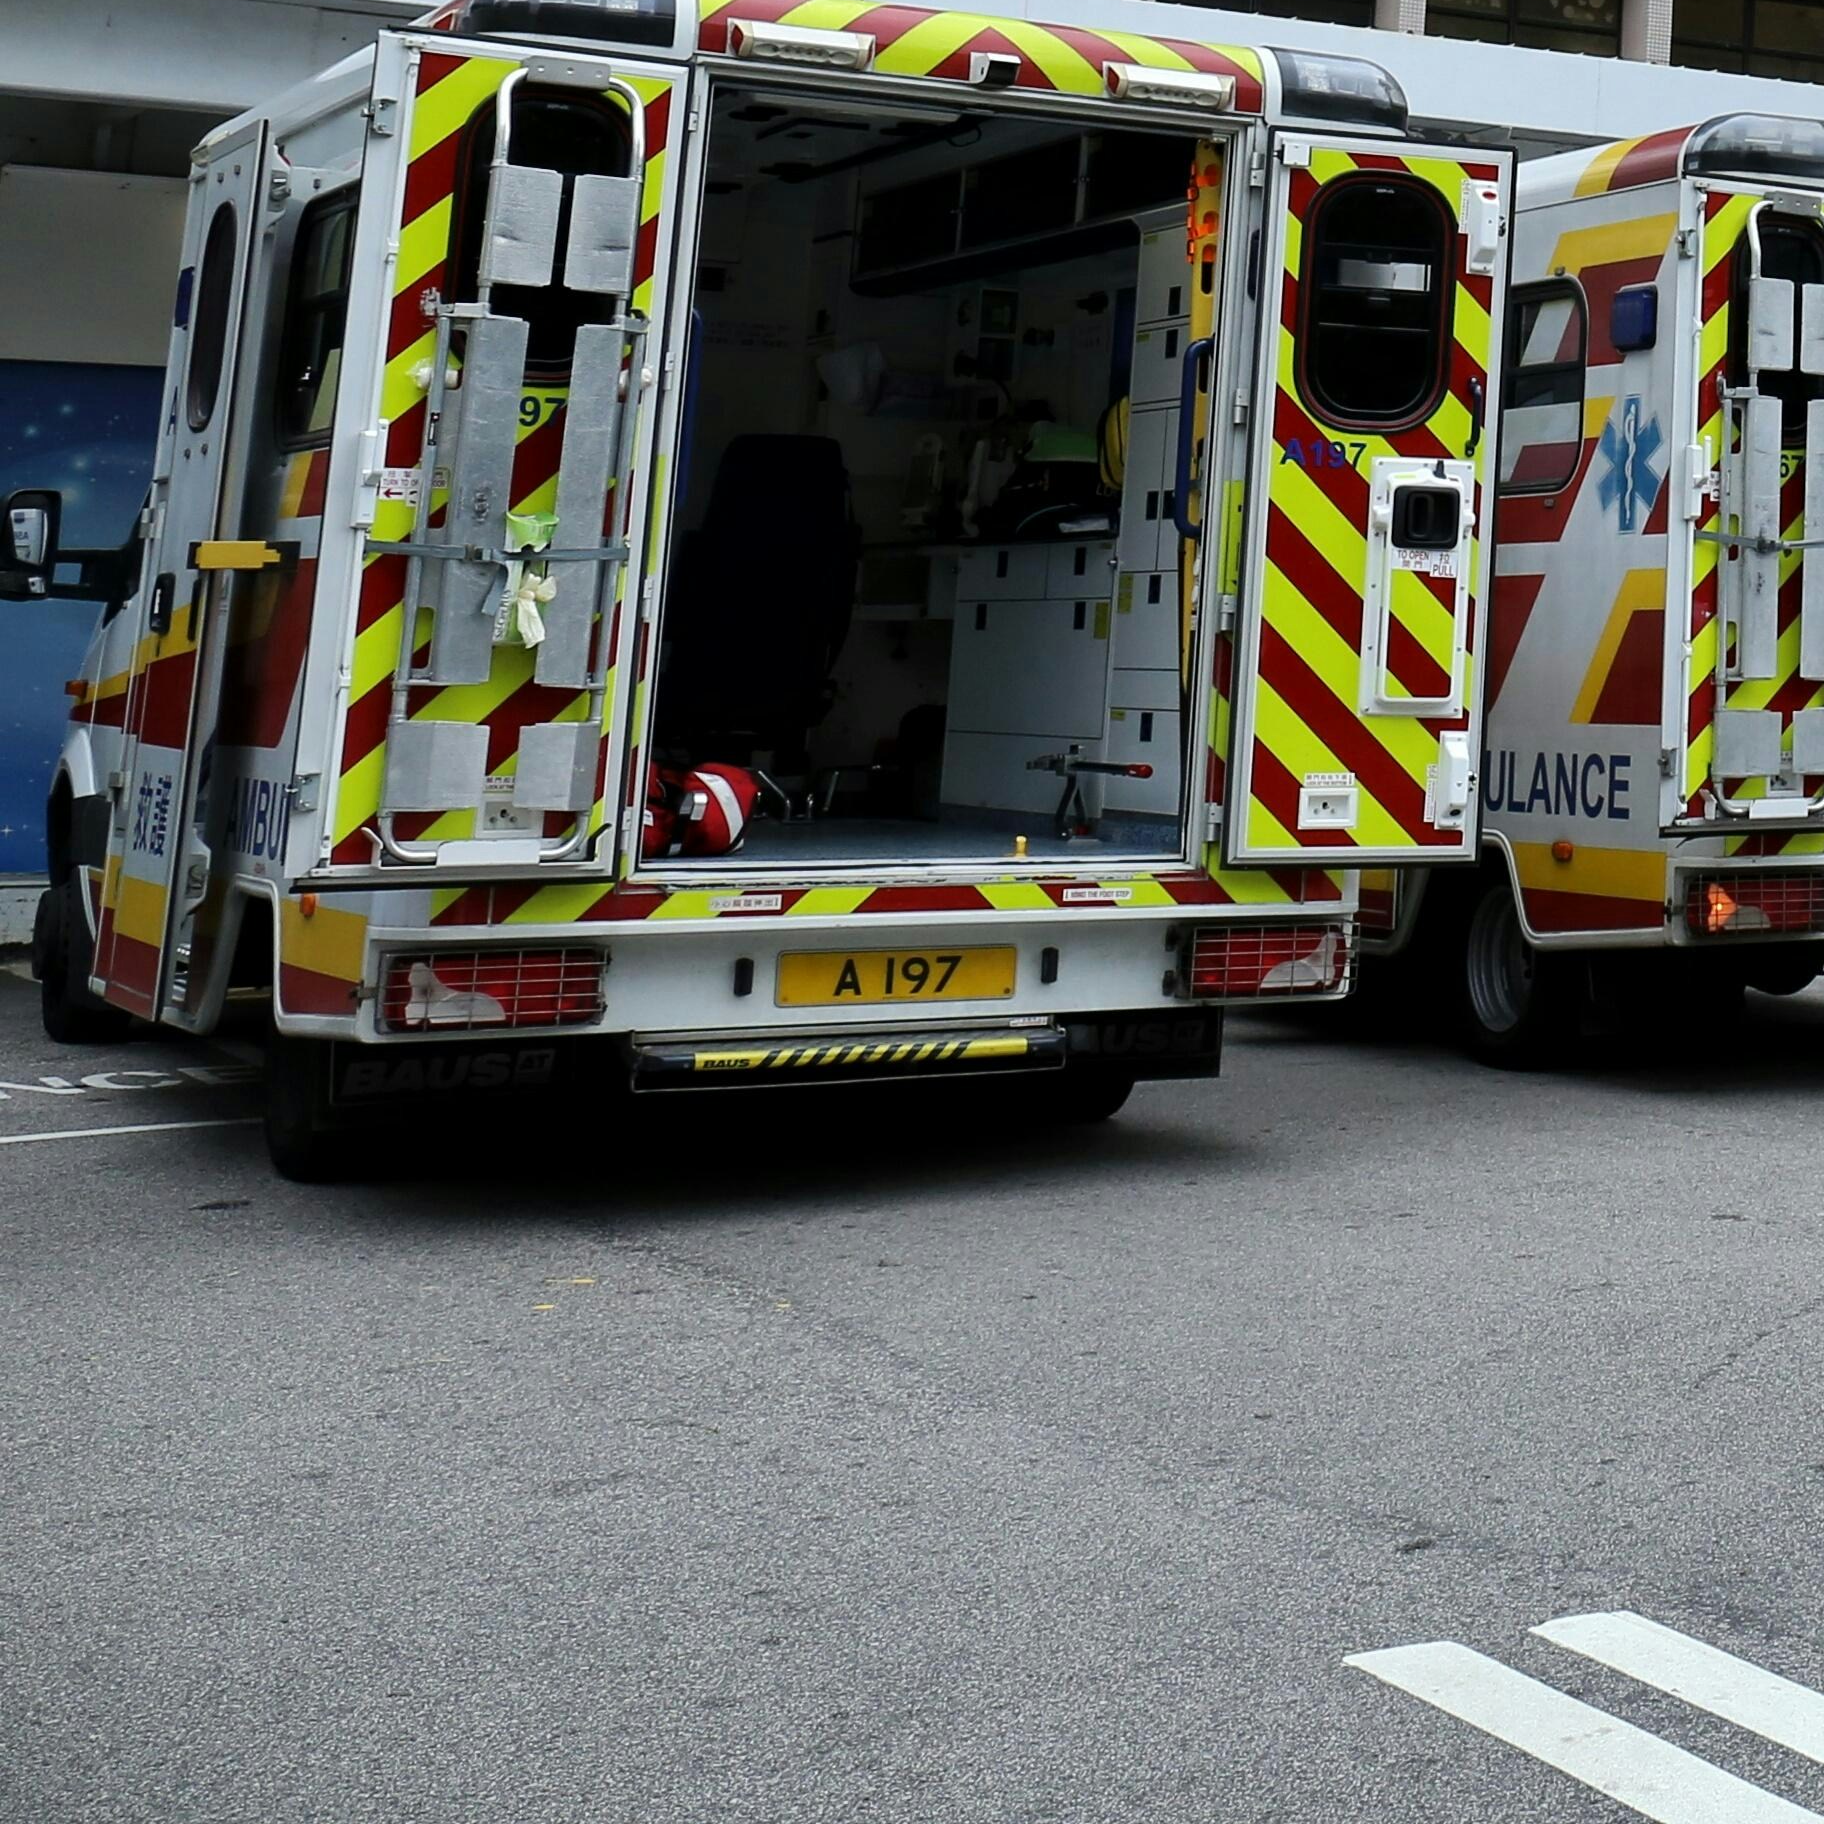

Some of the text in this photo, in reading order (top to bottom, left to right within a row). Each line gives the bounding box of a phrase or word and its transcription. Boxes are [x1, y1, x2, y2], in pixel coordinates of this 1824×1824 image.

[519, 396, 567, 427] 97
[1279, 438, 1367, 470] A197
[1780, 454, 1804, 478] 67
[1397, 550, 1429, 561] TO OPEN
[1432, 564, 1454, 576] PULL
[1485, 750, 1631, 820] ULANCE
[832, 955, 963, 997] A 197
[703, 1059, 750, 1070] BAUS
[0, 1064, 262, 1099] NCE
